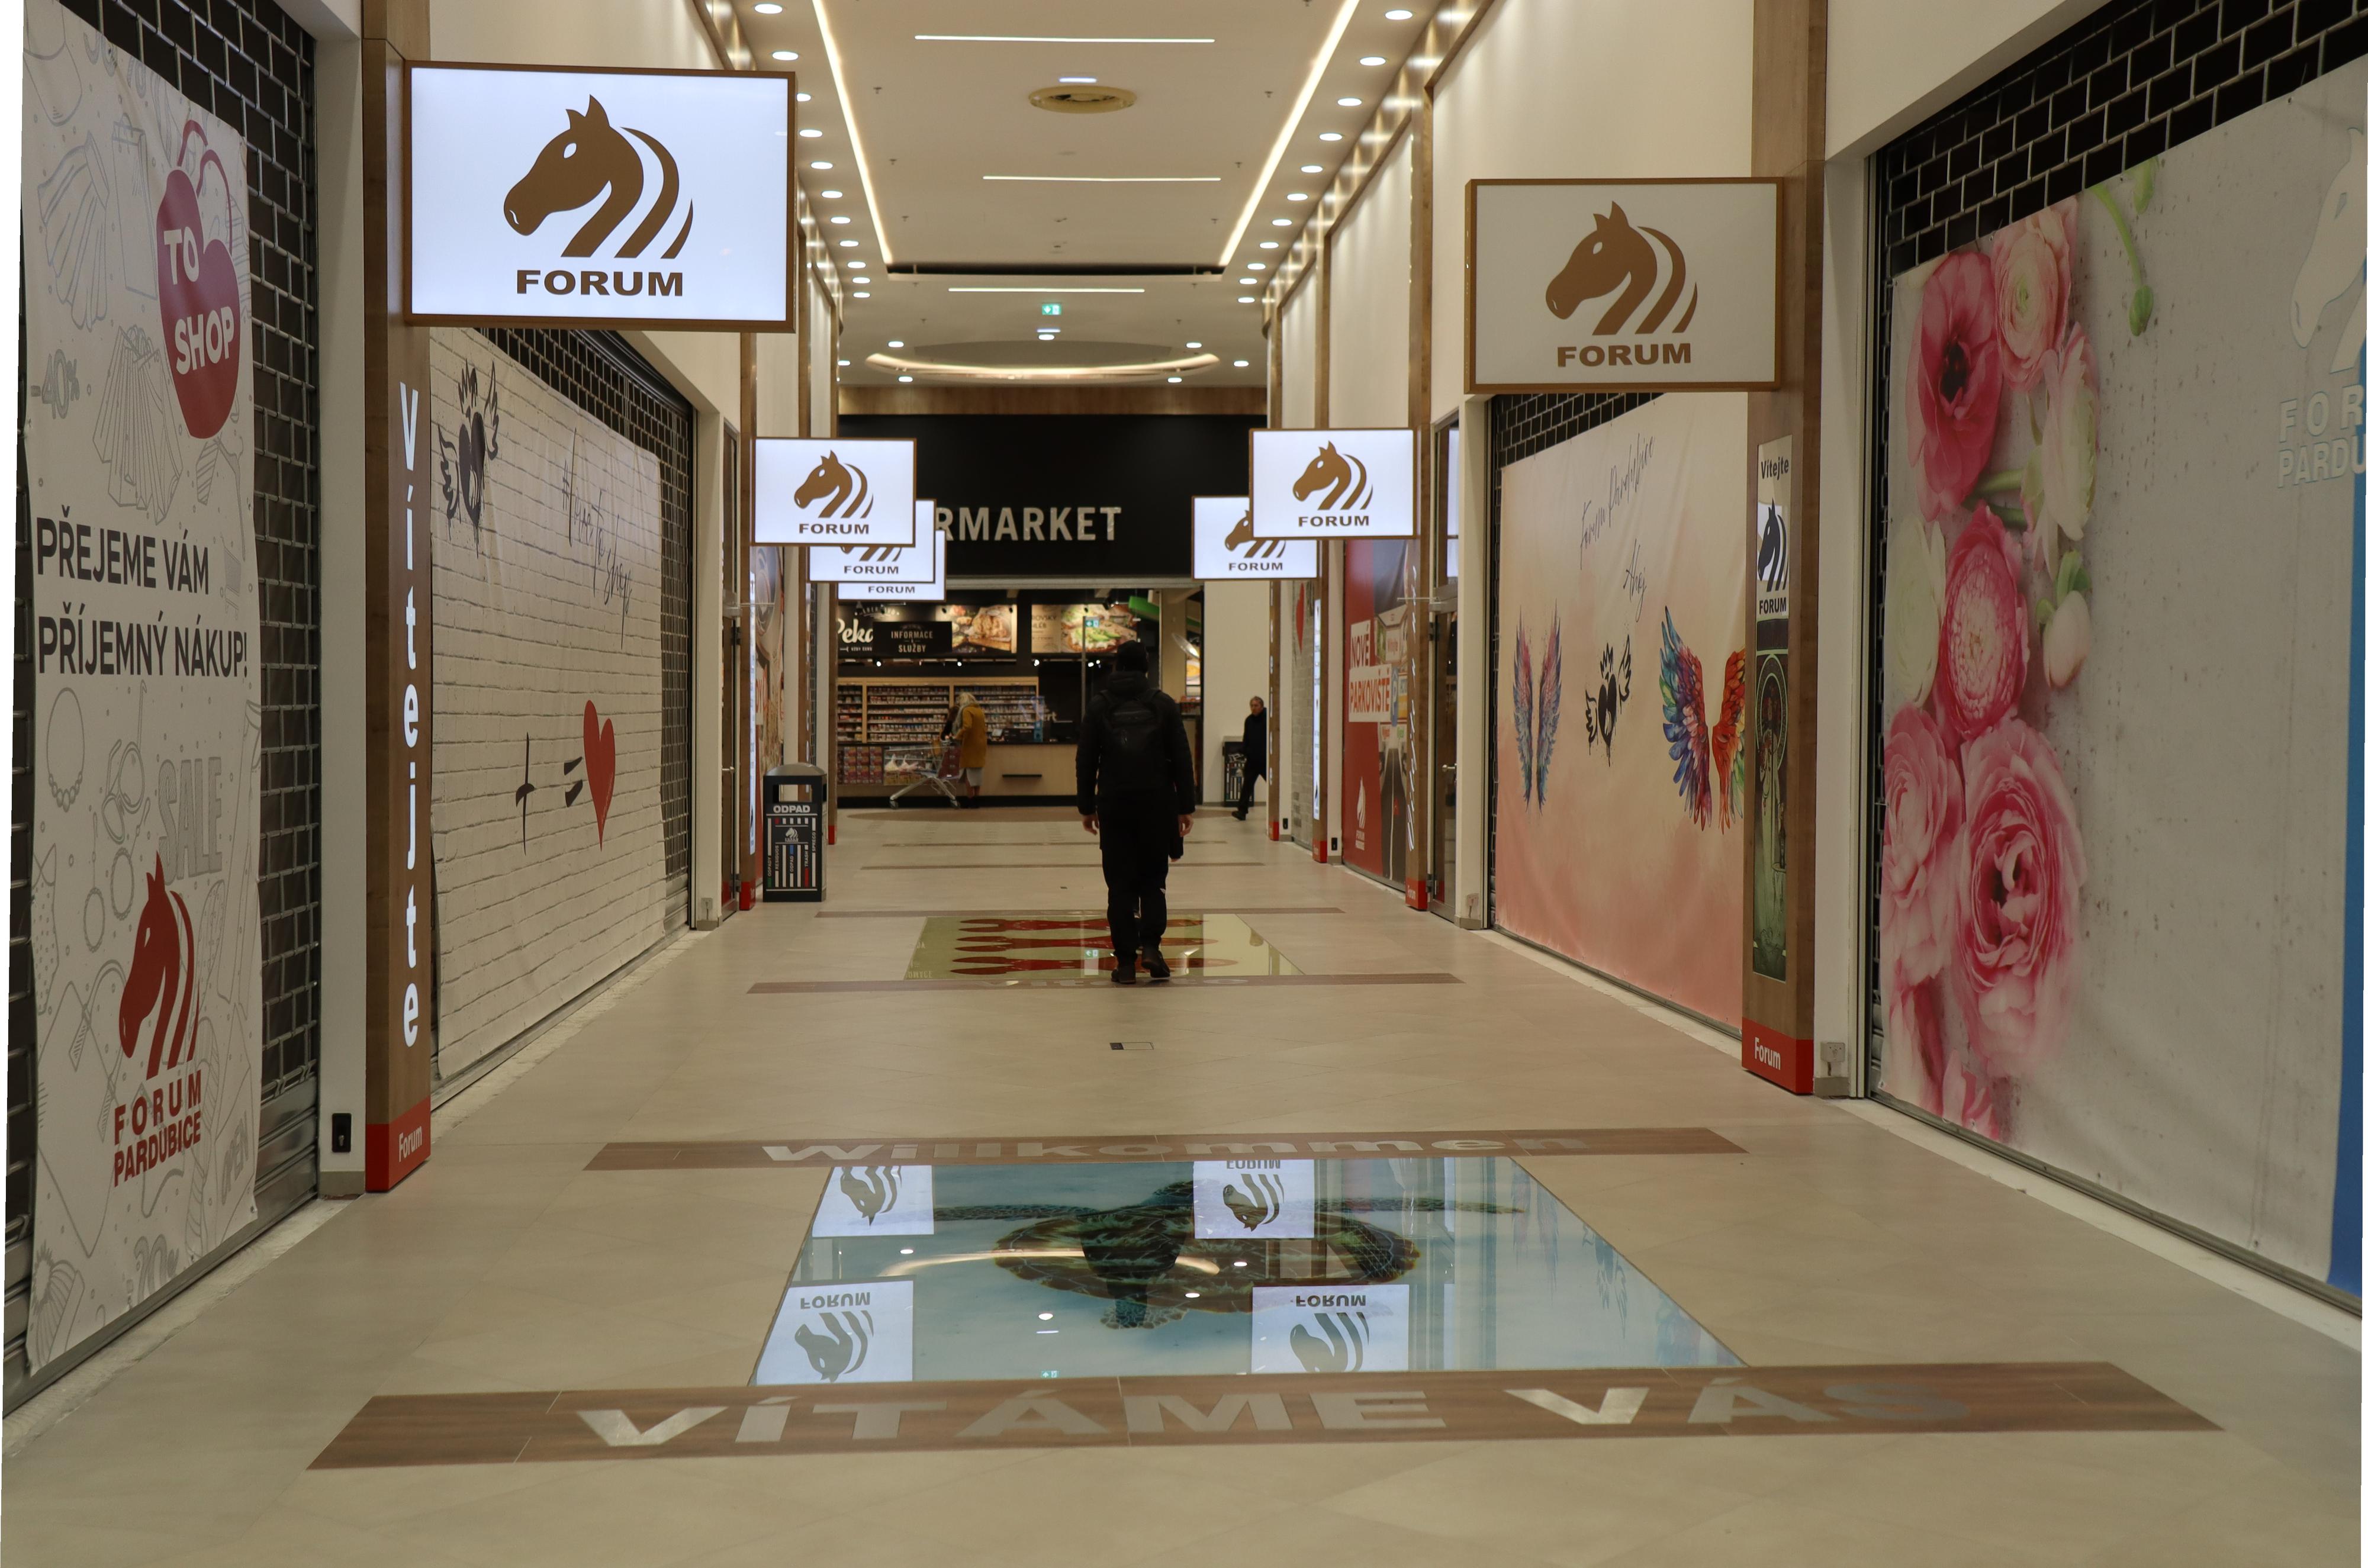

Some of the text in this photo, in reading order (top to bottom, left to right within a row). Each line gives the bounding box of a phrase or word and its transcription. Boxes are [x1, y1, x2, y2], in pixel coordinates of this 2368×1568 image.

[164, 226, 200, 285] TO
[516, 269, 683, 297] FORUM
[175, 306, 234, 375] SHOP
[1557, 343, 1691, 367] FORUM
[1761, 456, 1789, 481] Vítejte
[799, 523, 869, 535] FORUM
[1298, 515, 1370, 527] FORUM
[37, 505, 210, 595] PŘEJEME VÁM
[1228, 561, 1284, 571] FORUM
[844, 565, 899, 575] FORUM
[1759, 597, 1787, 615] FORUM
[38, 602, 248, 678] PŘÍJEMNÝ NÁKUP!
[898, 641, 926, 652] SLUŽBY
[1351, 623, 1370, 668] NOVÉ
[1350, 668, 1390, 713] PARKOVIŠTĚ
[158, 756, 223, 884] SALE
[773, 805, 810, 813] ODPAD
[1754, 1036, 1781, 1071] Forum
[114, 1069, 201, 1146] FORUM
[114, 1110, 201, 1187] PARDUBICE
[398, 1125, 423, 1163] Forum
[761, 1137, 1591, 1161] Willkommen
[575, 1377, 1973, 1447] VÍTÁME VÁS
